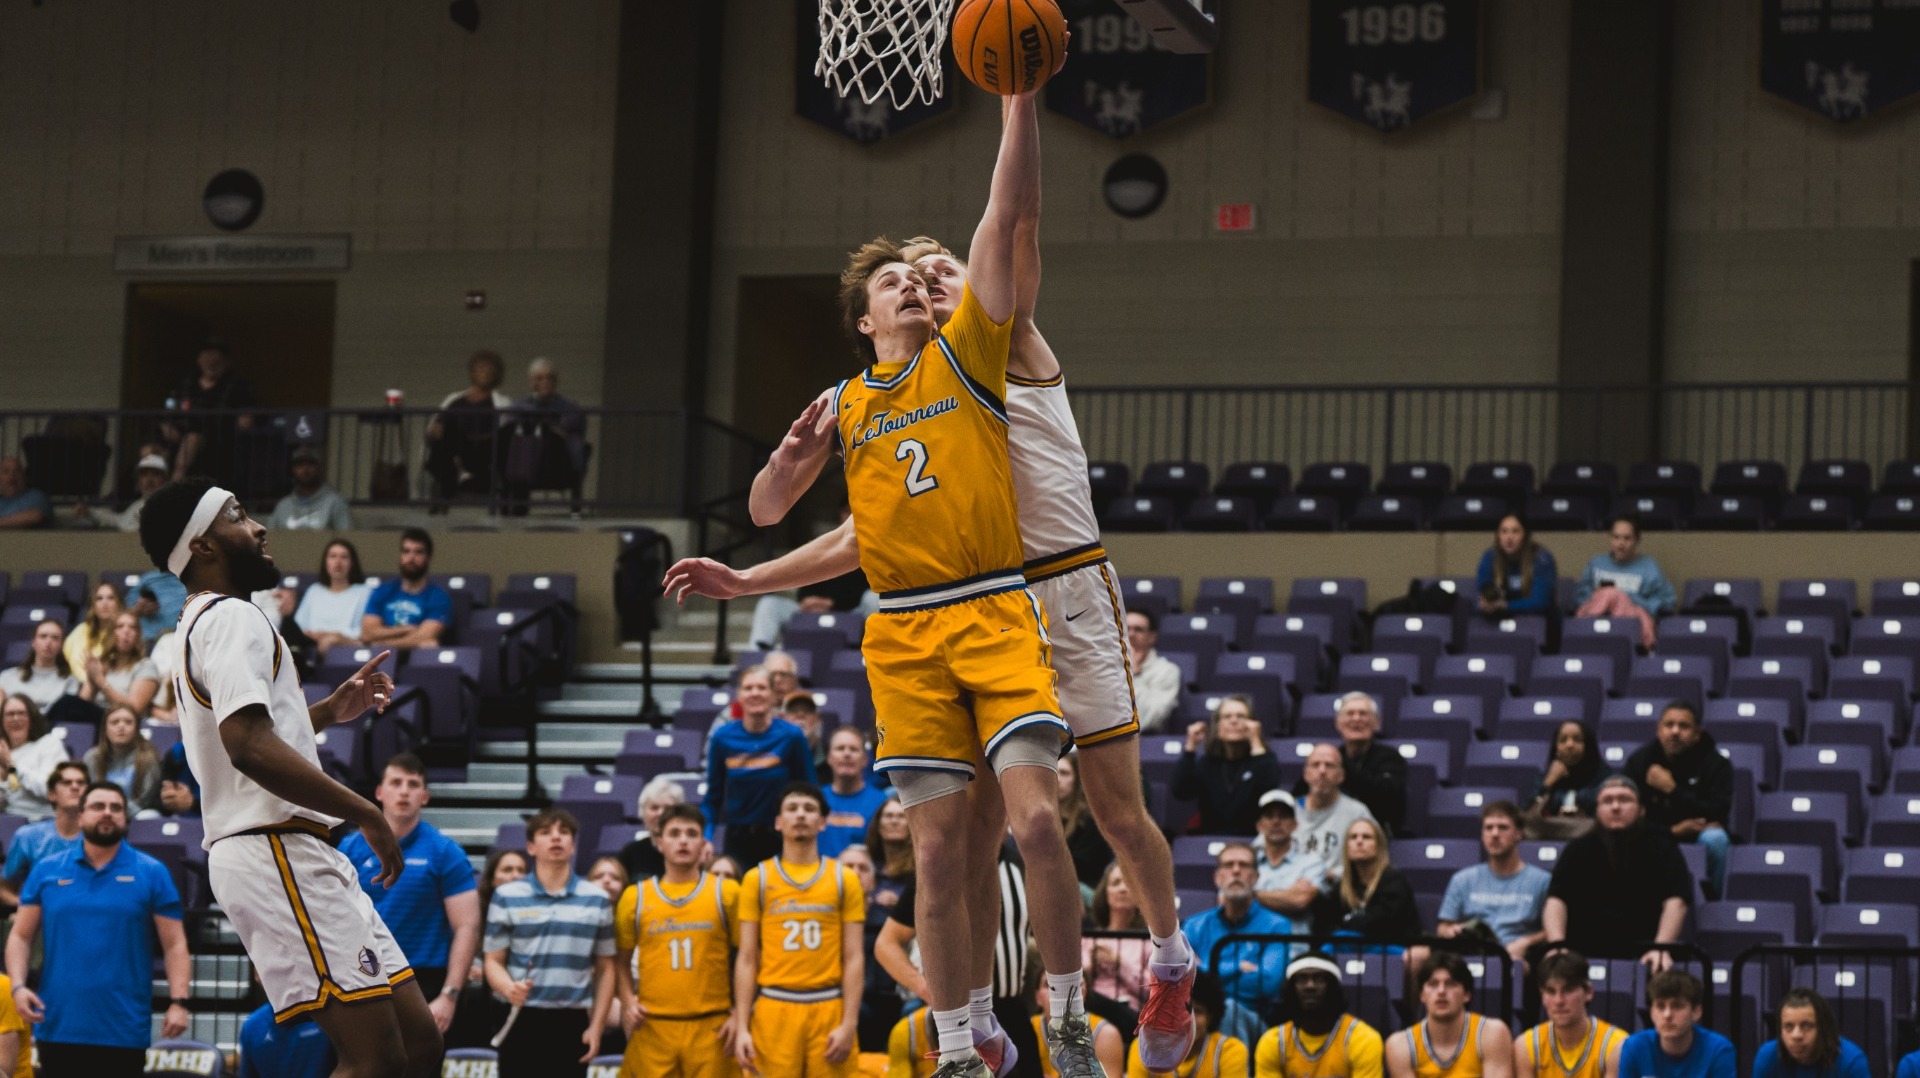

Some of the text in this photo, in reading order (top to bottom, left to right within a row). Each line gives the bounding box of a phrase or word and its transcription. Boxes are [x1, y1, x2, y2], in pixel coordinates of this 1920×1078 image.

[1338, 2, 1447, 46] 1996
[852, 396, 958, 449] LeTourneau
[895, 438, 939, 497] 2
[669, 937, 692, 970] 11
[782, 920, 821, 951] 20
